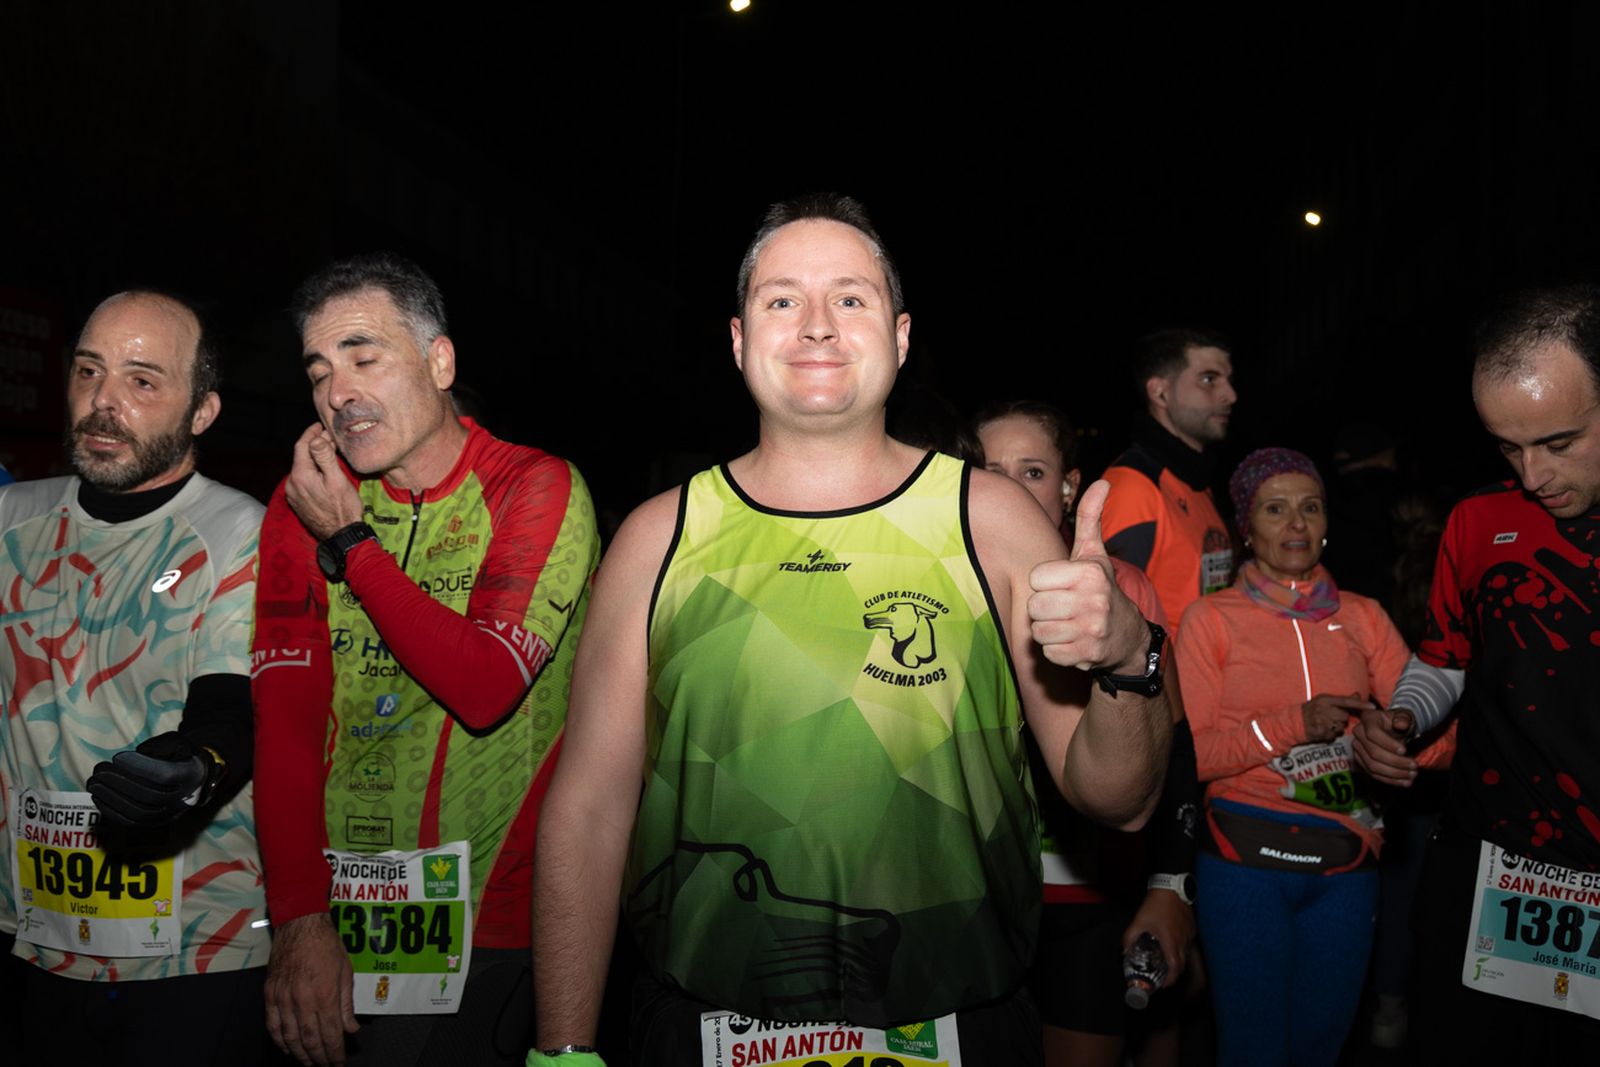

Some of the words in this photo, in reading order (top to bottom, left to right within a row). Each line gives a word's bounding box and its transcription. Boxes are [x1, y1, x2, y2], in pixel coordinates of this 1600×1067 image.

[778, 562, 852, 573] TEAMERGY
[864, 593, 885, 609] CLUB
[887, 591, 899, 599] DE
[901, 590, 949, 615] ATLETISMO
[863, 663, 915, 687] HUELMA
[918, 668, 947, 687] 2003
[1297, 749, 1333, 767] NOCHE
[349, 783, 394, 791] MOLIENDA
[39, 808, 85, 826] NOCHE
[25, 824, 49, 844] SAN
[1259, 847, 1322, 864] SALOMON
[28, 847, 158, 900] 13945
[340, 863, 386, 879] NOCHE
[388, 865, 406, 880] DE
[1522, 861, 1578, 885] NOCHE
[331, 884, 351, 900] AN
[355, 881, 408, 900] ANTÓN
[1499, 874, 1535, 895] SAN
[1538, 883, 1600, 907] ANTÓN
[1533, 951, 1559, 966] José
[714, 1027, 720, 1036] de
[714, 1037, 722, 1058] Enero
[732, 1036, 778, 1067] SAN
[782, 1024, 863, 1059] ANTÓN
